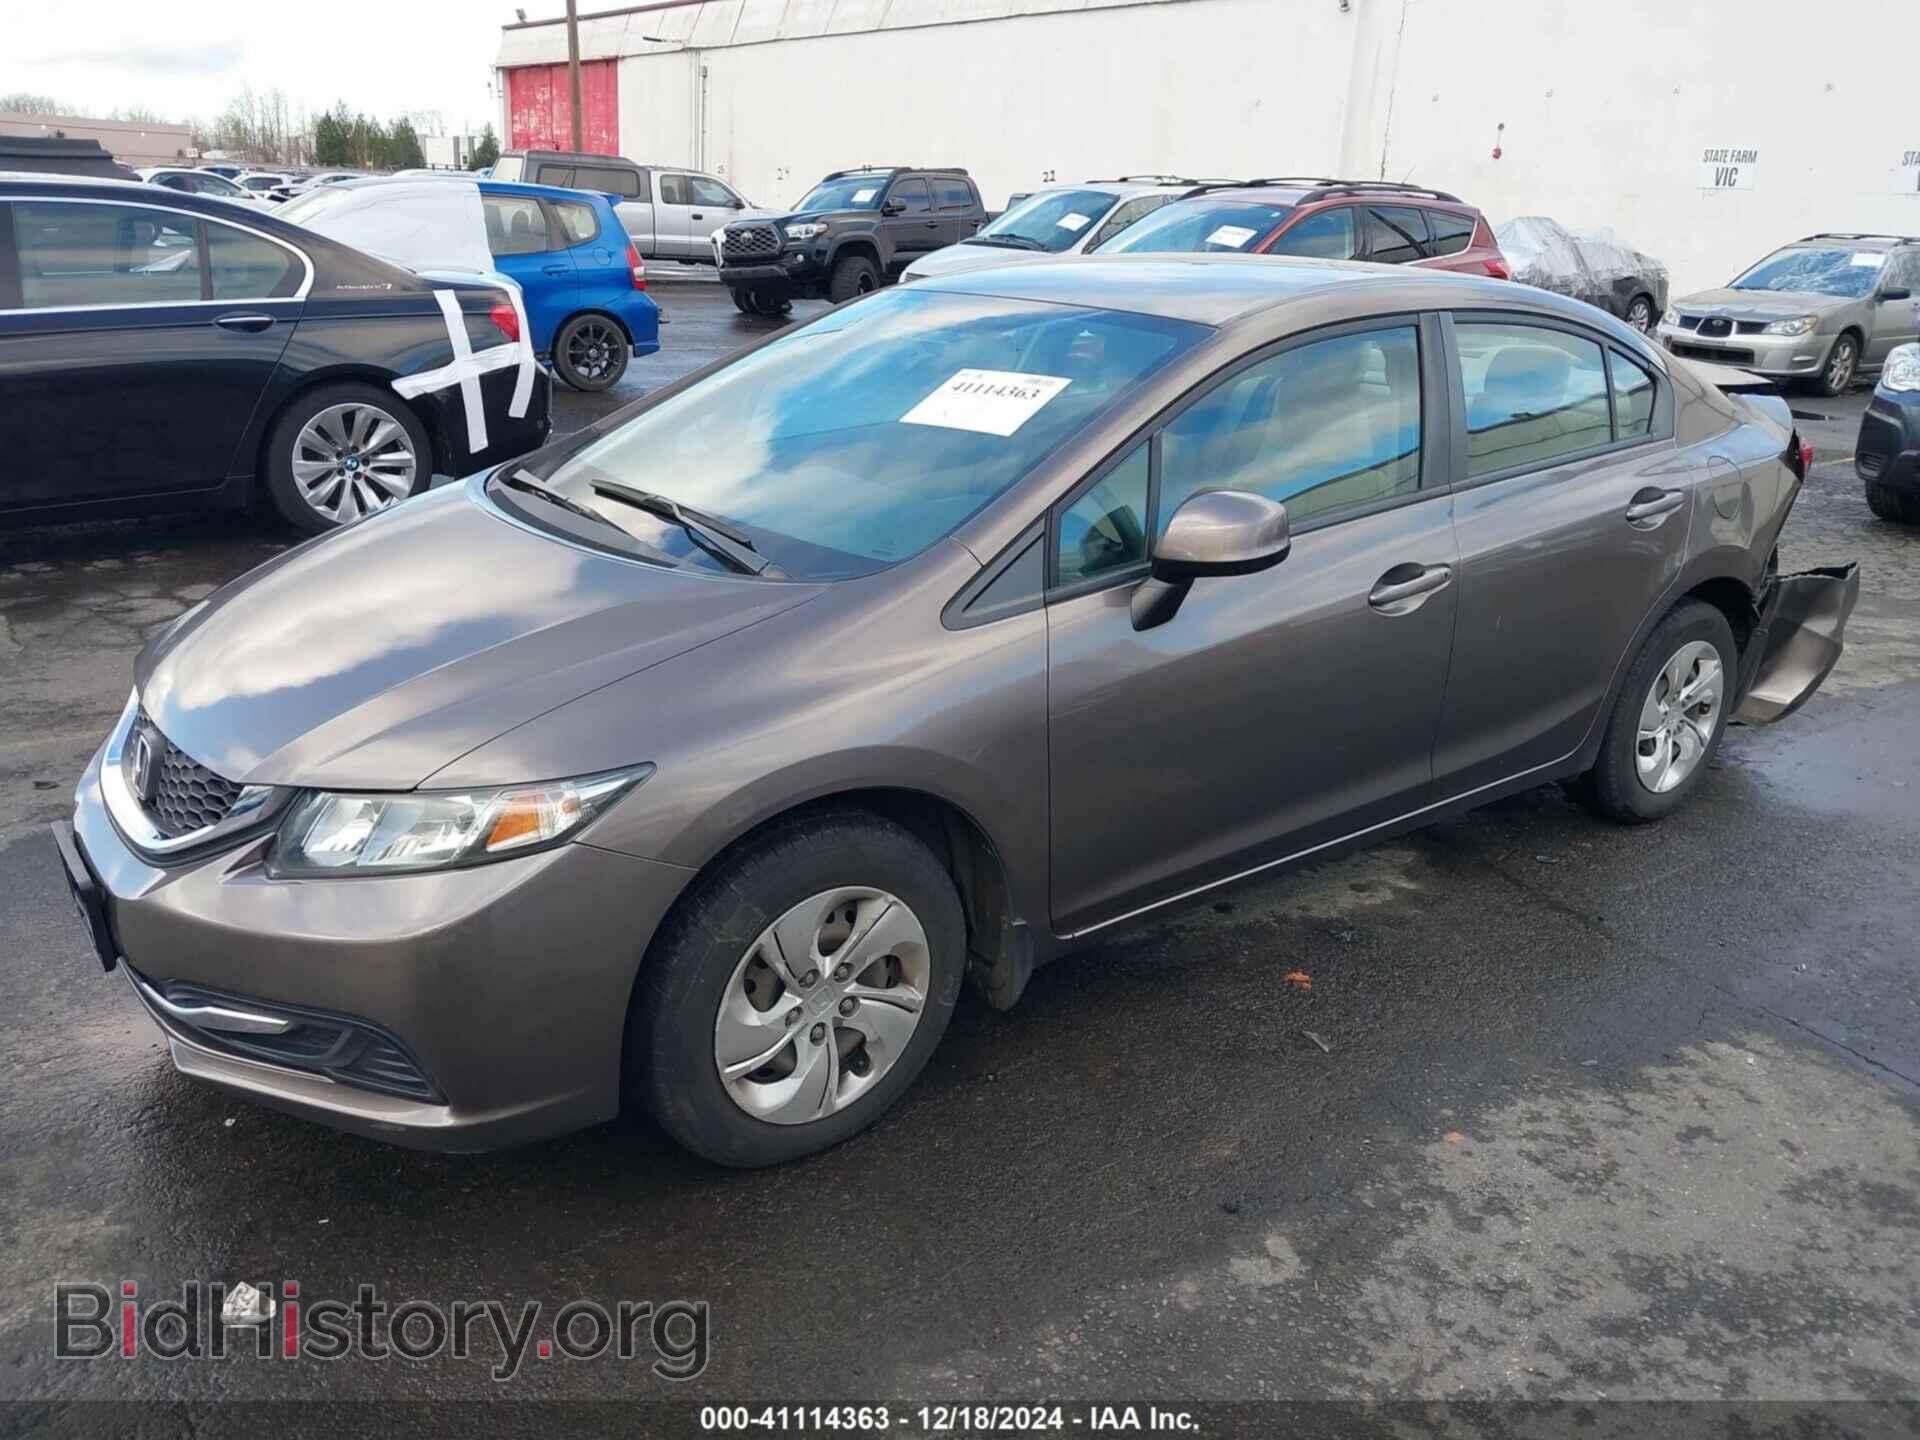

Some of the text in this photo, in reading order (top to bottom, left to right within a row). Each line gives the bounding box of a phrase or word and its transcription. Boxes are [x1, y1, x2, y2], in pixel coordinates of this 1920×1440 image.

[1703, 149, 1758, 164] STATE FARM
[1715, 167, 1738, 187] VIC
[952, 382, 1041, 400] 41114363
